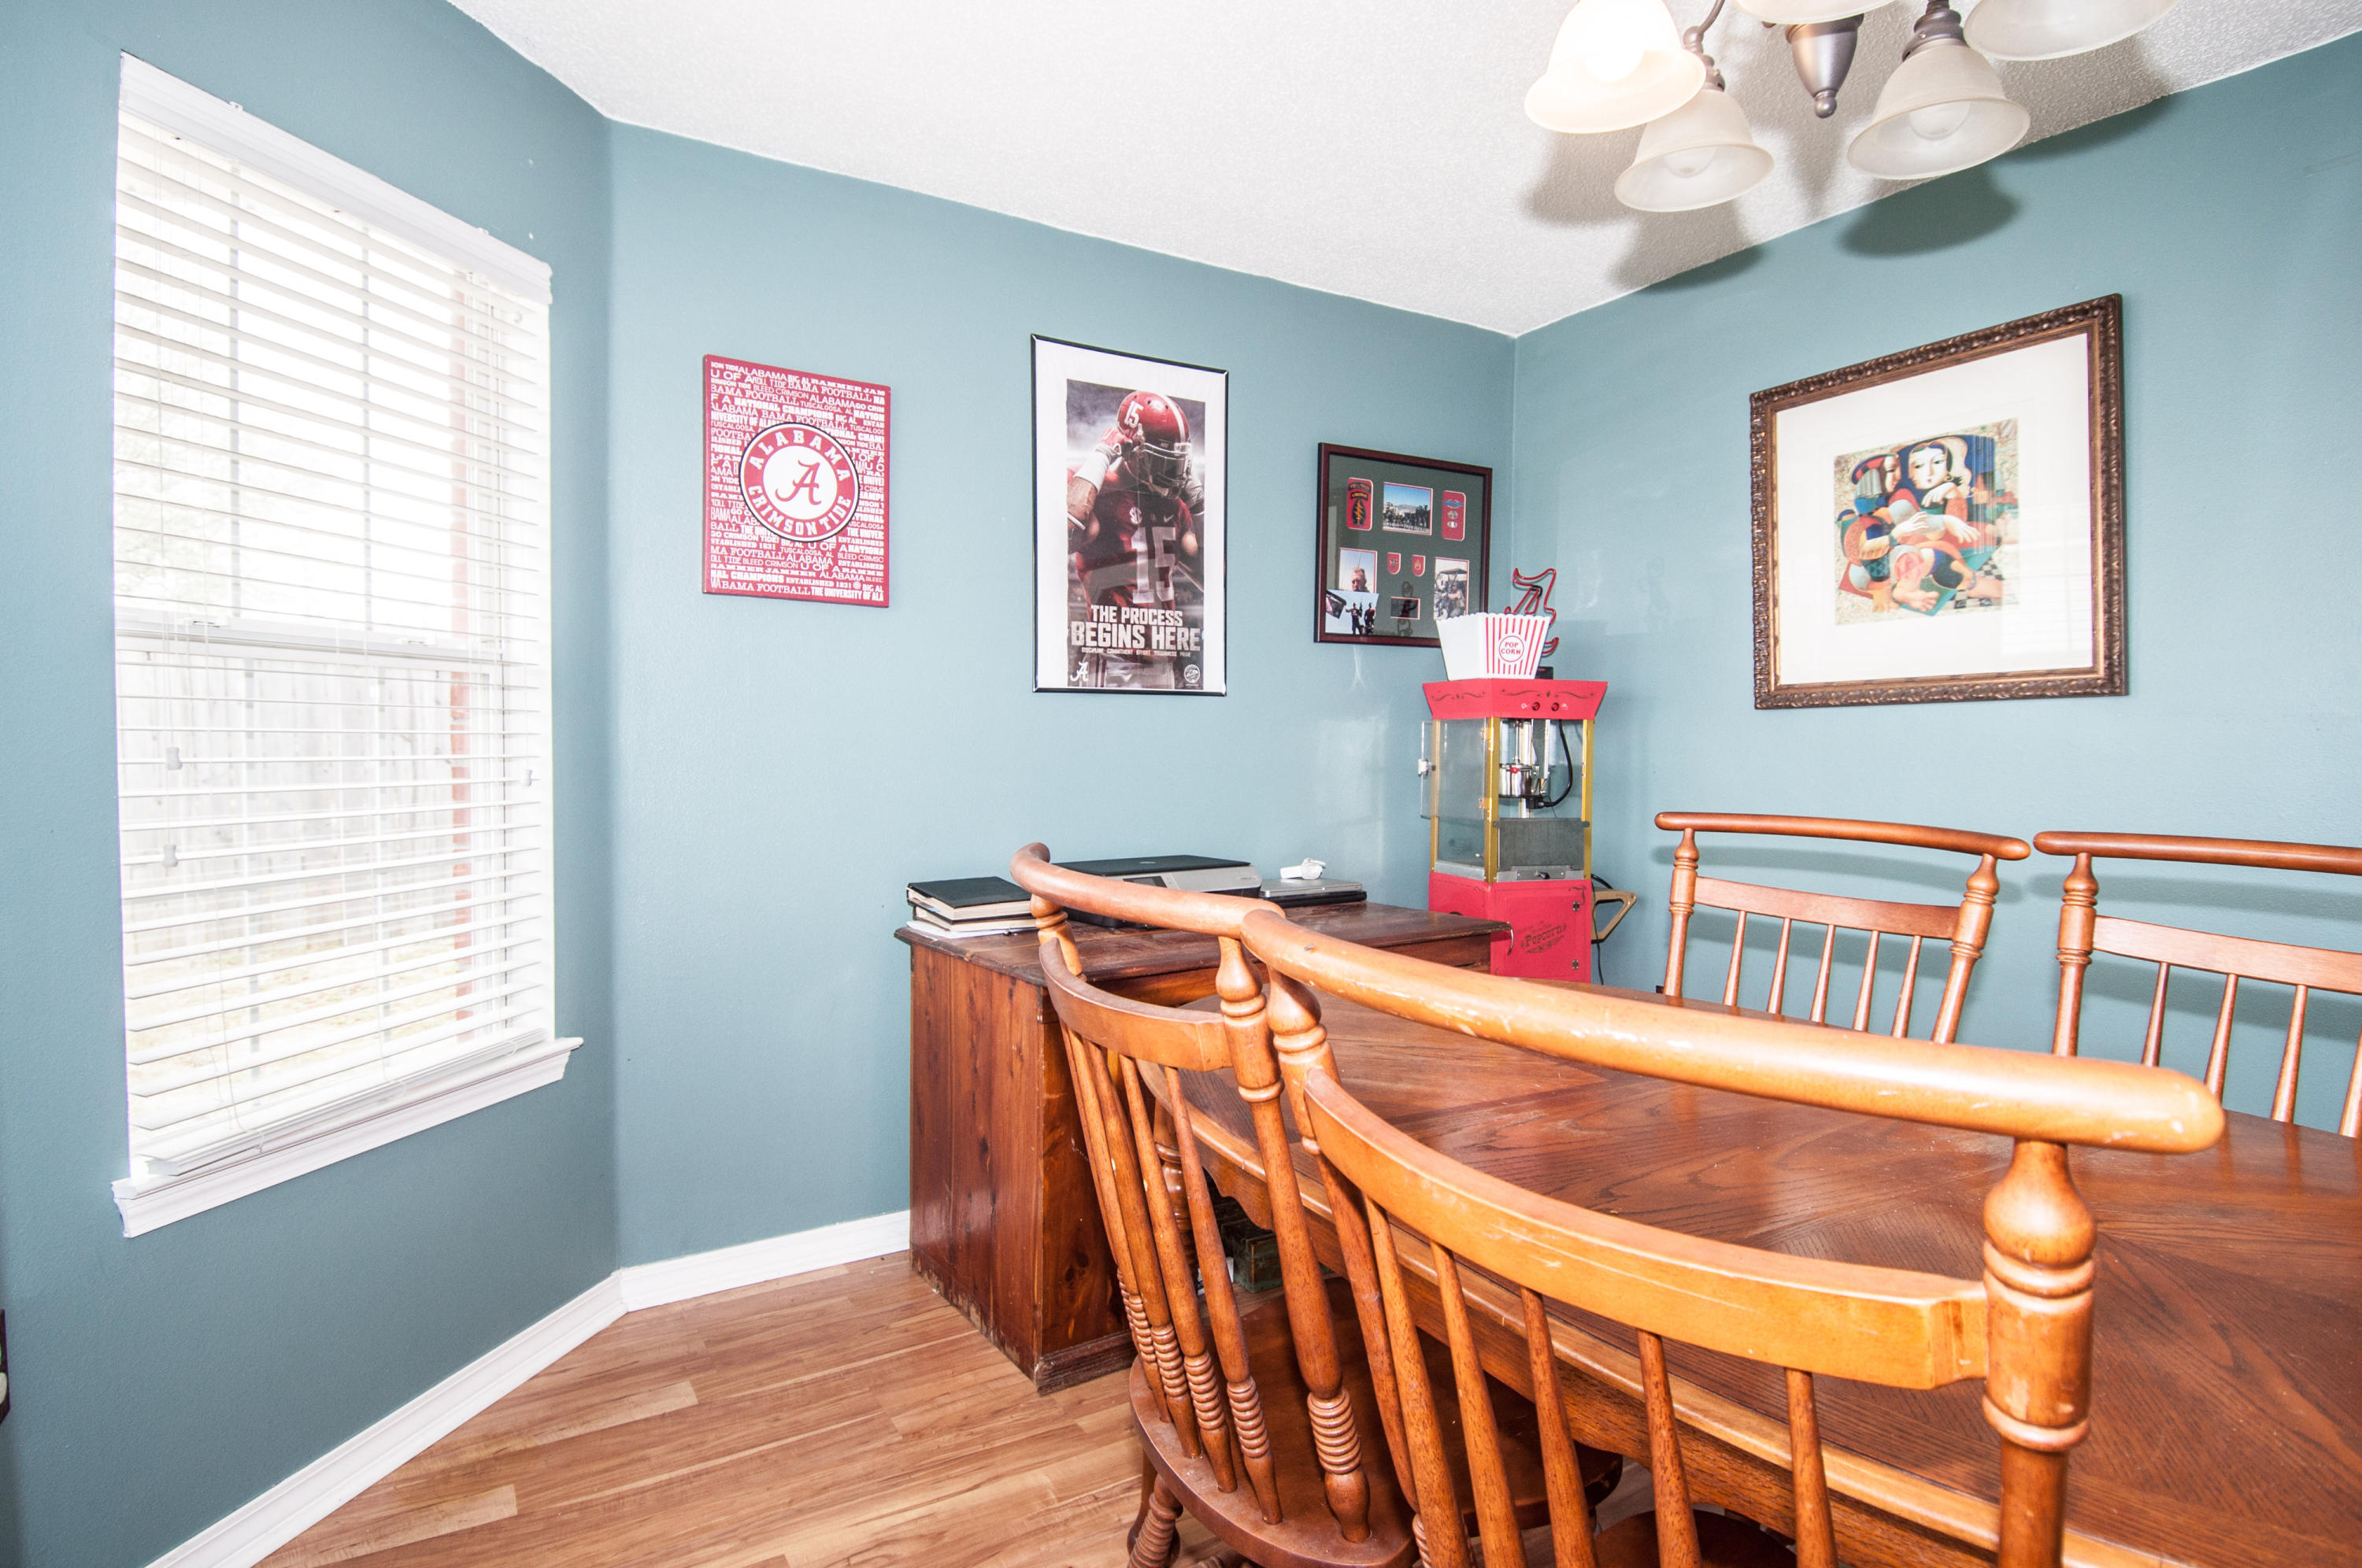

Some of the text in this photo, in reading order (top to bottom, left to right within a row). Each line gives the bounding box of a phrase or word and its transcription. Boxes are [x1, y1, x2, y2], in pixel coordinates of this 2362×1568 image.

[738, 366, 787, 381] ALABAMA
[724, 371, 741, 380] OF
[787, 380, 818, 393] BAMA
[821, 386, 872, 401] FOOTBALL
[745, 390, 798, 405] FOOTBALL
[809, 394, 855, 409] ALABAMA
[1124, 401, 1144, 428] 15
[749, 430, 850, 481] ALABAMA
[775, 459, 822, 505] A
[749, 485, 851, 536] CRIMSON TIDE
[731, 547, 784, 560] FOOTBALL
[786, 553, 833, 565] ALABAMA
[820, 571, 864, 581] ALABAMA
[1091, 605, 1183, 627] THE PROCESS
[1071, 621, 1201, 651] BEGINS HERE
